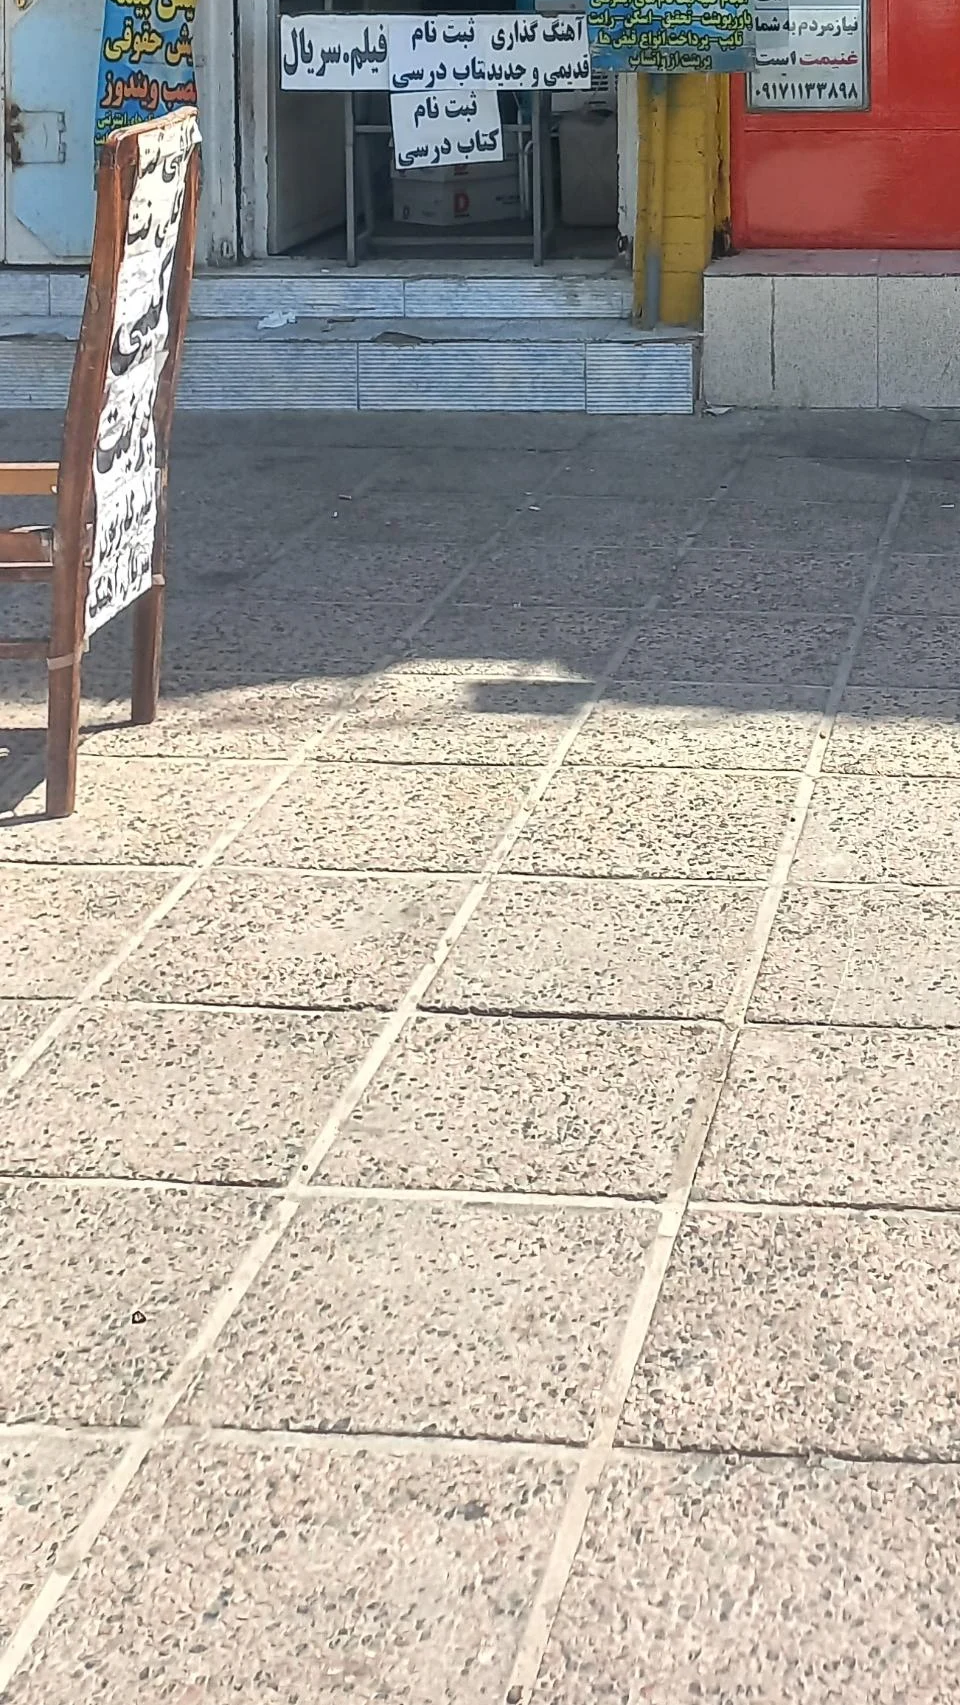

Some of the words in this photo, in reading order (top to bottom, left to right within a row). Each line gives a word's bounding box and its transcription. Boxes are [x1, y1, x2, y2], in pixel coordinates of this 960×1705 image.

[411, 19, 438, 50] نام
[442, 17, 476, 45] ثبت
[490, 20, 539, 51] گذاری
[542, 15, 584, 43] آهنگ
[754, 16, 781, 32] شما
[798, 19, 834, 37] مردم
[832, 16, 858, 37] نیاز
[103, 16, 164, 64] حقوقی
[164, 22, 194, 67] یش
[452, 58, 486, 85] تاب
[486, 59, 527, 87] جدید
[543, 52, 590, 88] قدیمی
[755, 50, 797, 67] است
[799, 50, 858, 69] غنیمت
[392, 59, 447, 89] درسی
[530, 64, 540, 88] و
[100, 70, 160, 111] ویندوز
[161, 71, 198, 112] صب
[444, 90, 478, 119] ثبت
[755, 81, 858, 100] ۰۹۱۷۱۱۳۳۸۹۸
[413, 96, 440, 128] نام
[397, 137, 452, 167] درسی
[456, 127, 500, 160] کتاب
